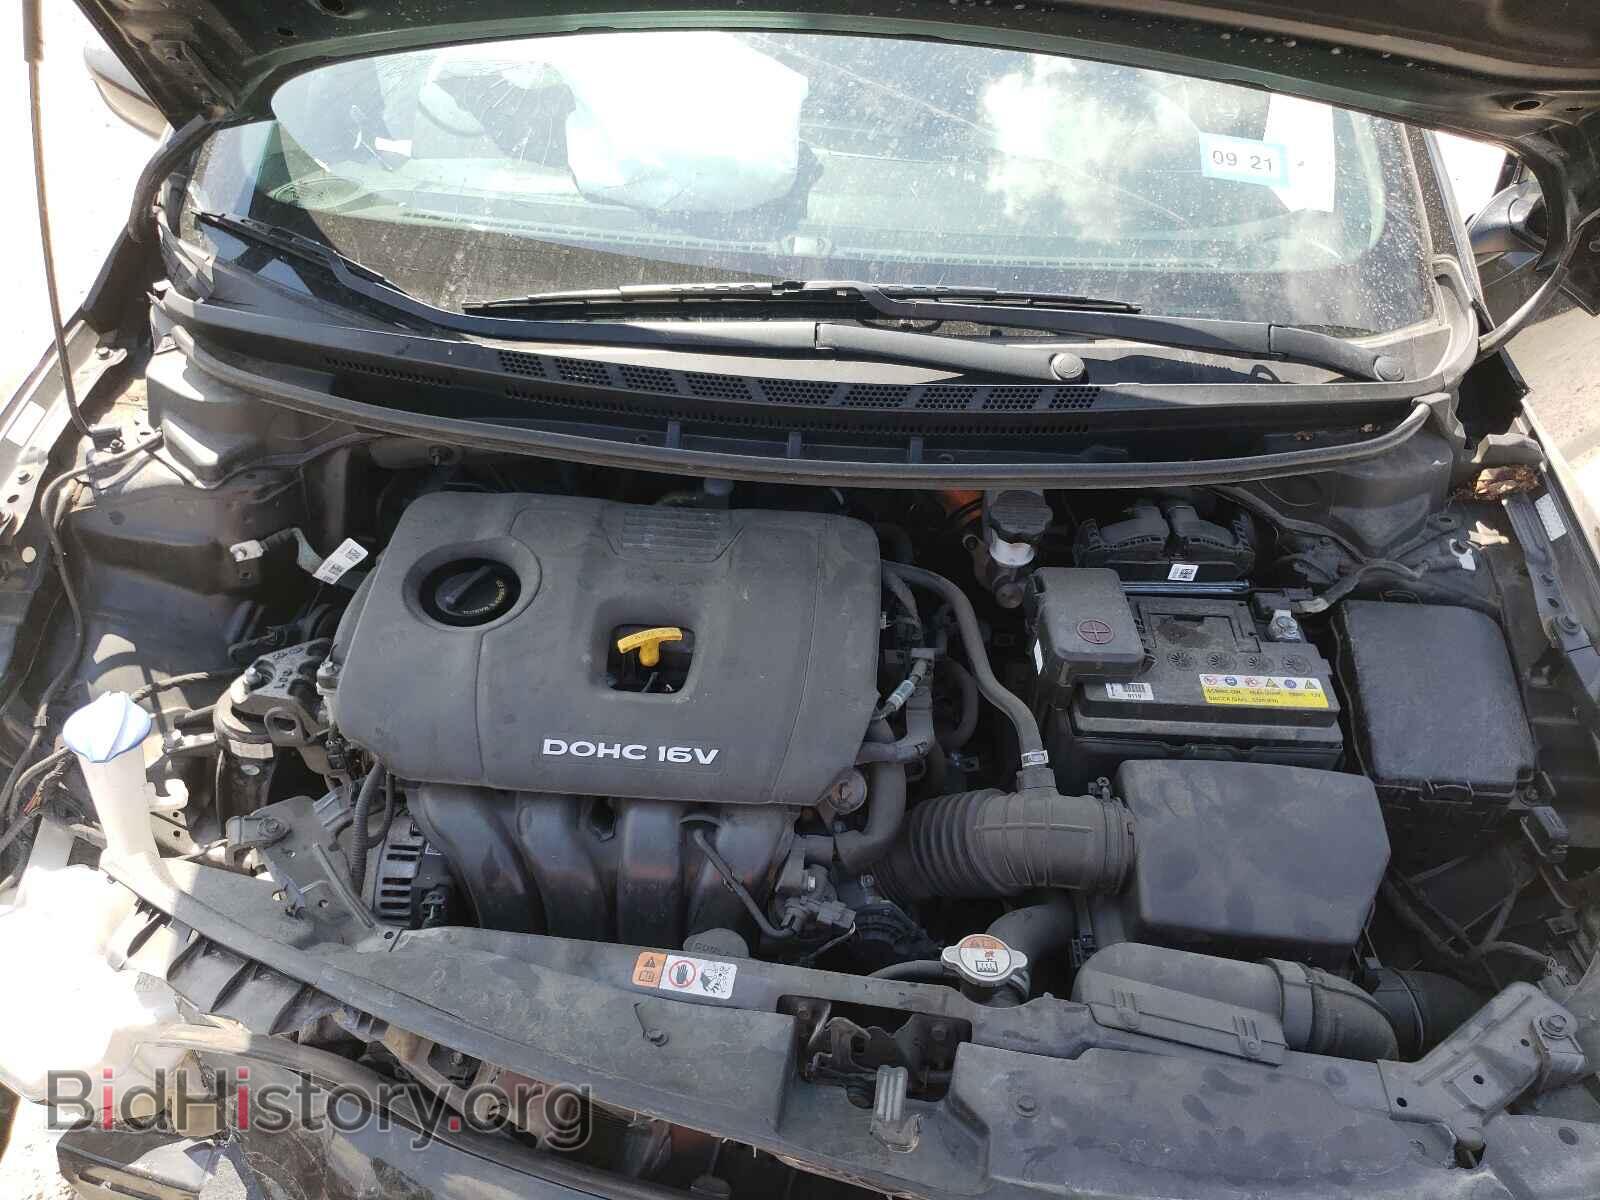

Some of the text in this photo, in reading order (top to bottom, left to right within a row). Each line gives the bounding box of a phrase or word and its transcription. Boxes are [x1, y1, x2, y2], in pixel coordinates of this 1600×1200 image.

[1212, 150, 1272, 172] 09 21
[543, 739, 719, 764] DOHC 16V
